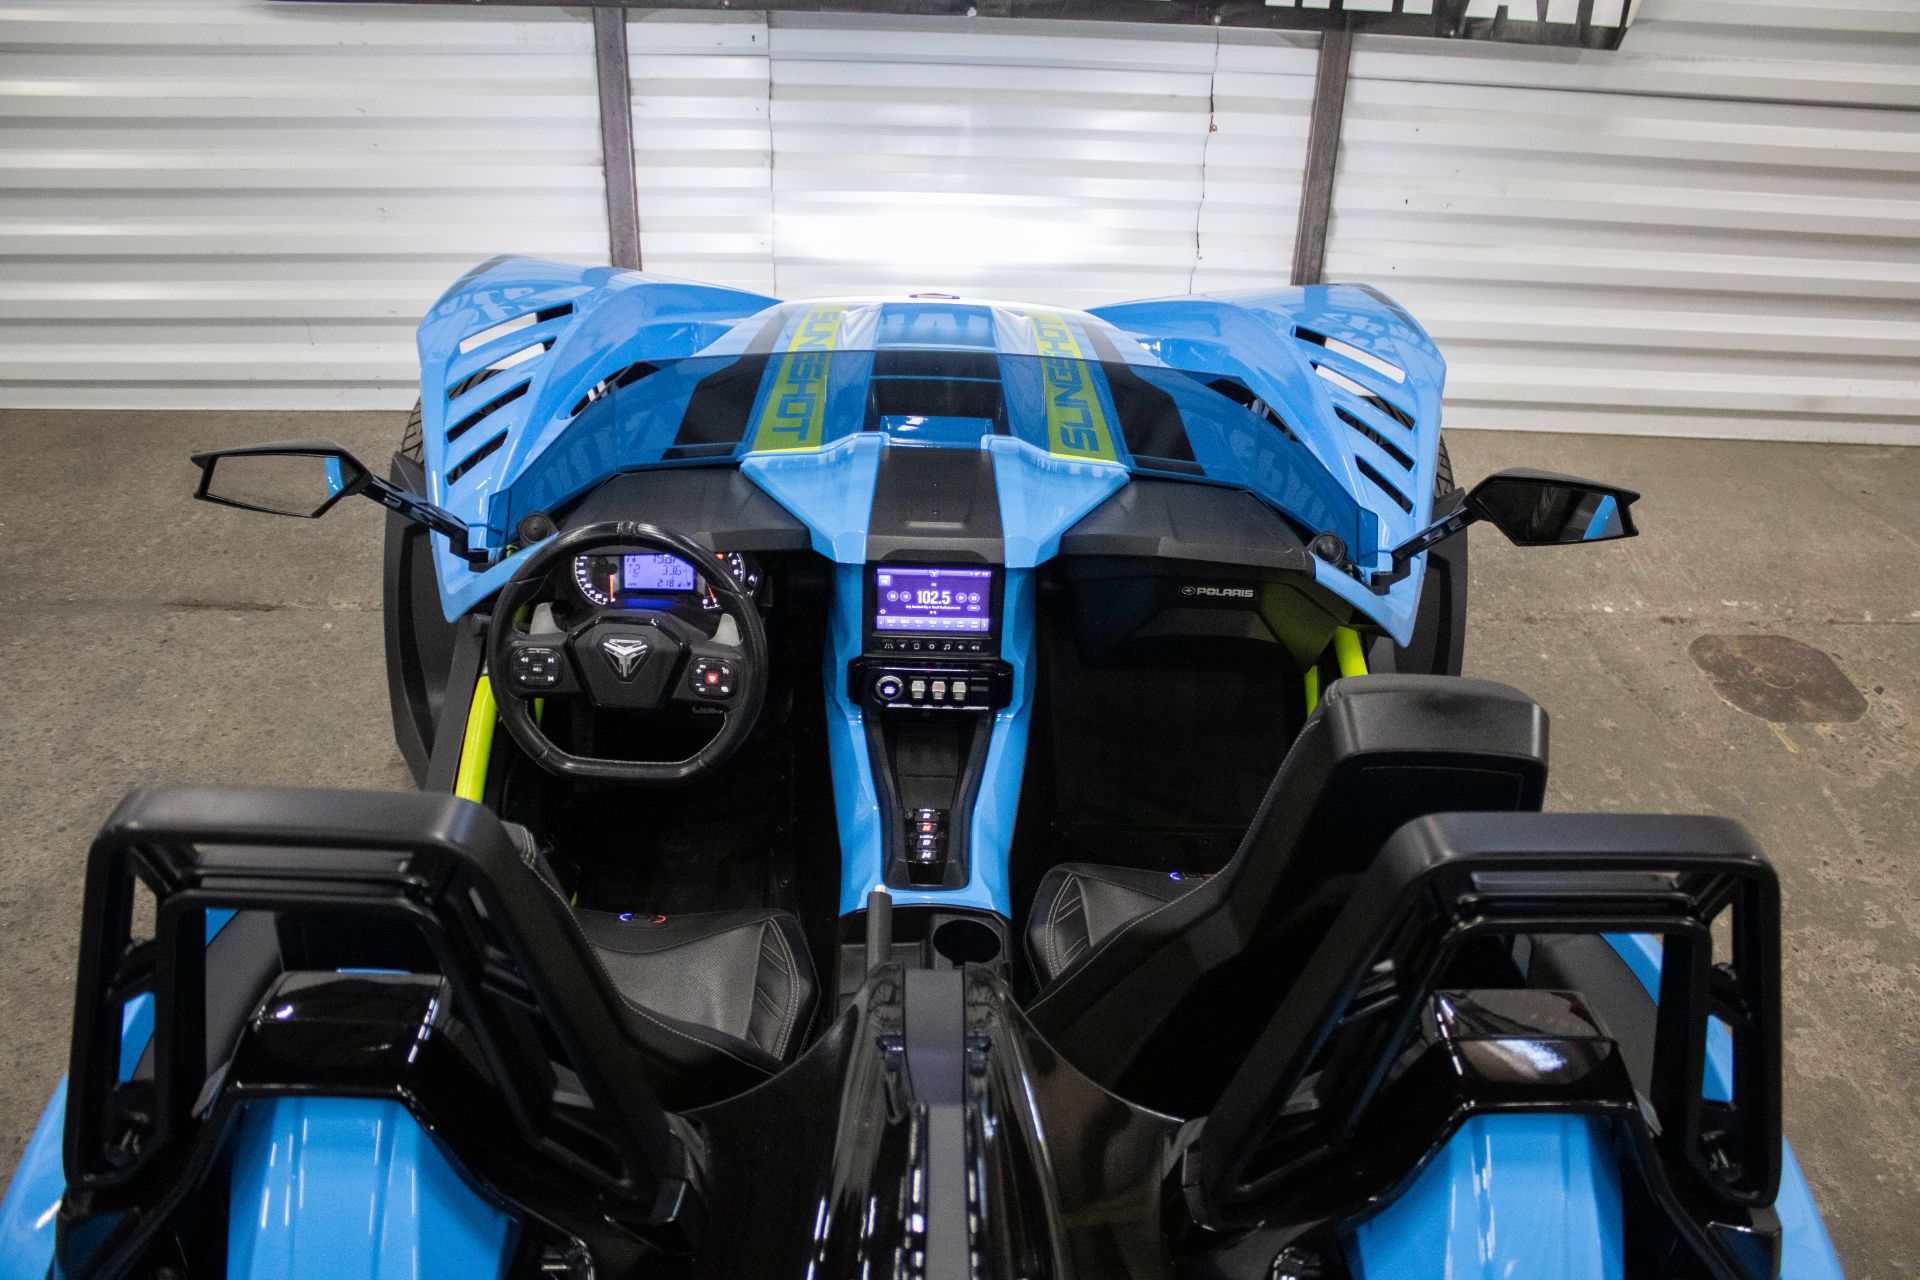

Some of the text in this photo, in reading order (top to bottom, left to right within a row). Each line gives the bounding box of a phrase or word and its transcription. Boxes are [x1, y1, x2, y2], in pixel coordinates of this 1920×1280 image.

[1036, 317, 1101, 452] SLINGSHOT
[916, 590, 951, 605] 102.5
[1196, 587, 1254, 598] POLARIS
